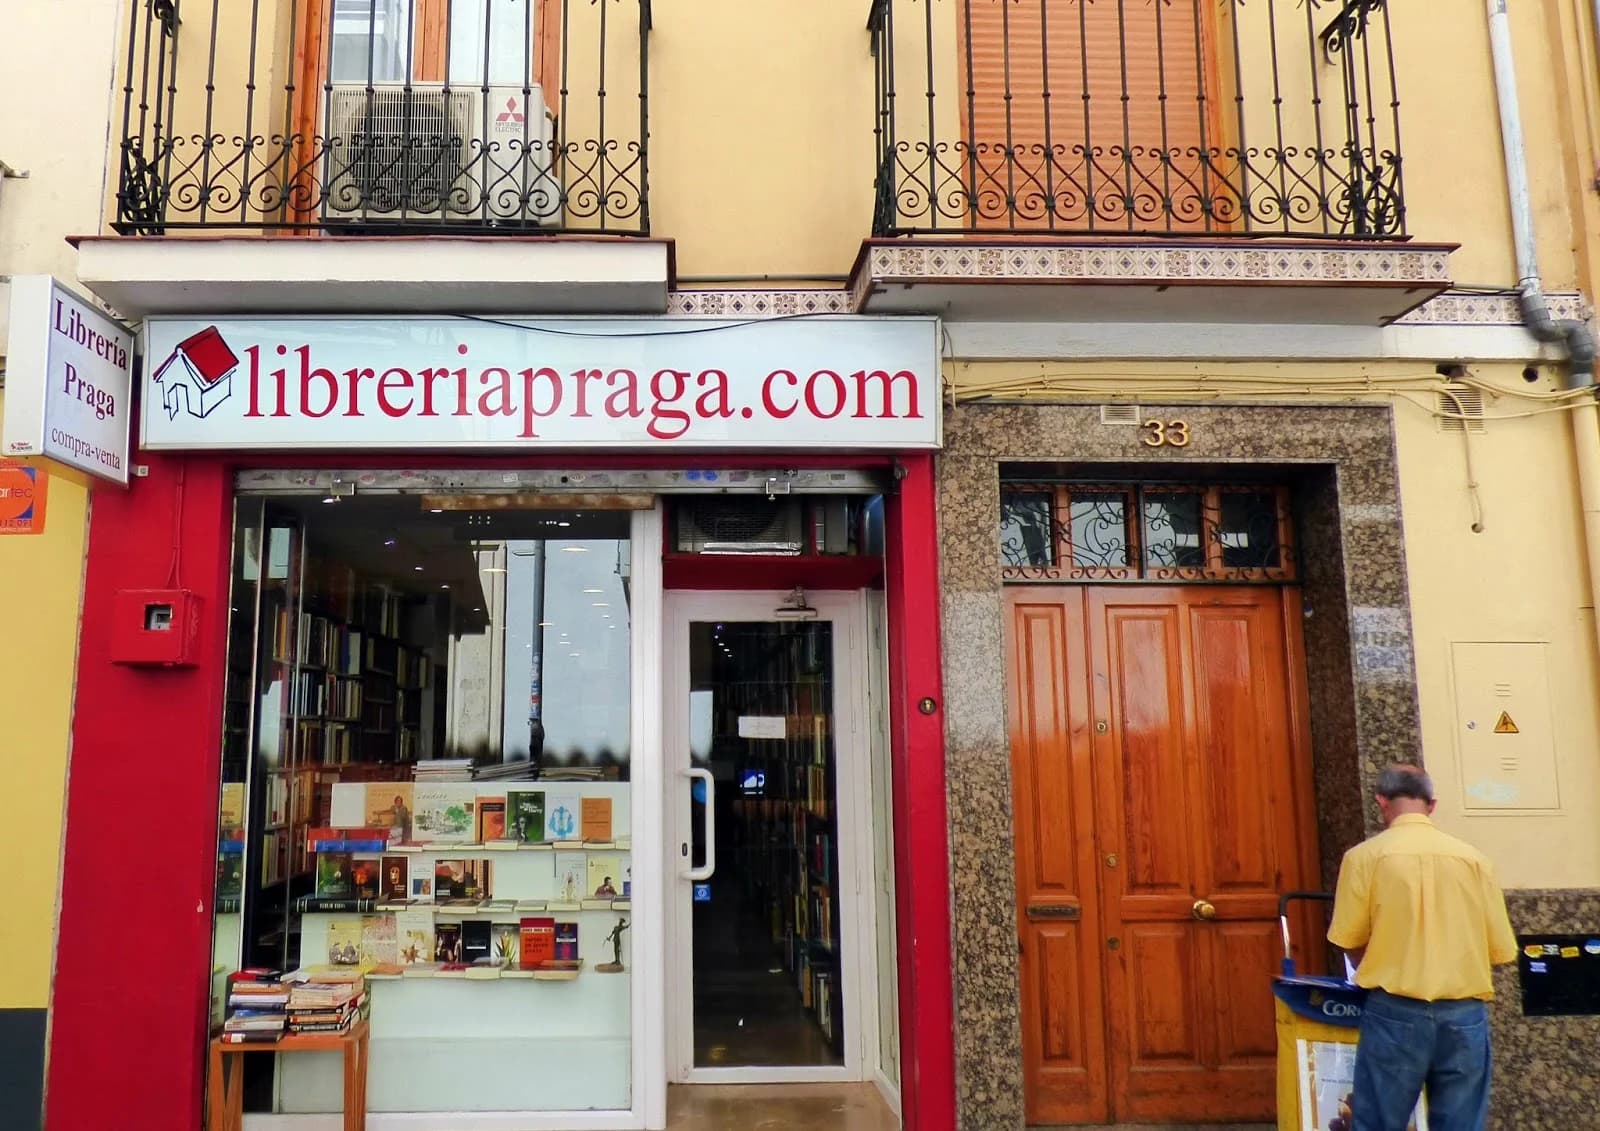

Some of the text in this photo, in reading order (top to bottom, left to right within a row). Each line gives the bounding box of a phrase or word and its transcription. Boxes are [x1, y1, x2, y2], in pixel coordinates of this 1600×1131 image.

[54, 298, 128, 371] Librería
[63, 361, 116, 421] Praga
[243, 343, 924, 439] libreriapraga.com
[51, 427, 121, 470] compra-venta
[1144, 419, 1190, 447] 33
